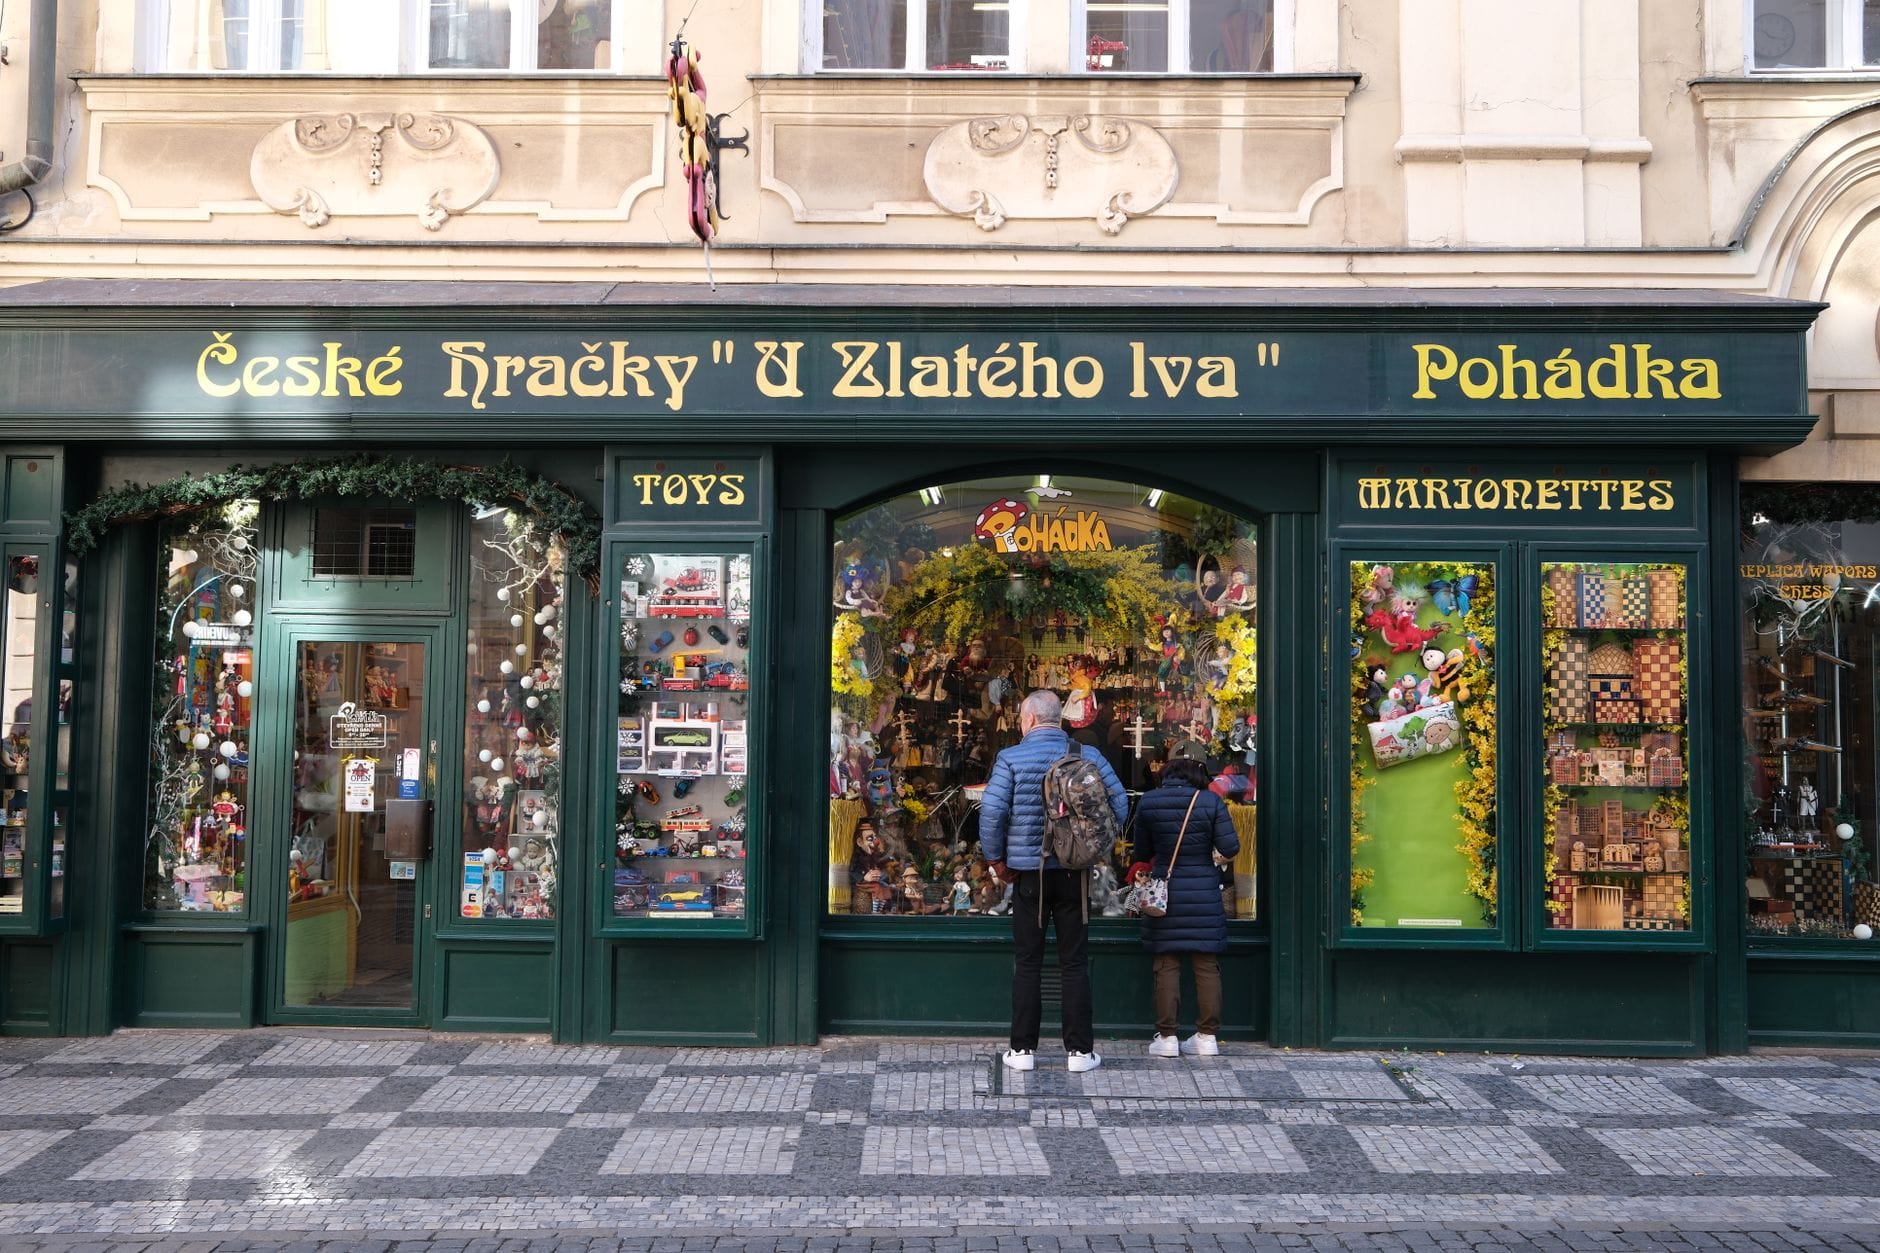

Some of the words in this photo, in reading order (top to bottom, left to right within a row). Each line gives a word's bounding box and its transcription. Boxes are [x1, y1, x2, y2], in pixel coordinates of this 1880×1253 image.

[197, 331, 404, 398] České
[442, 341, 698, 410] Hračky
[832, 341, 1104, 398] Zlatého
[1412, 343, 1722, 400] Pohádka
[632, 474, 746, 505] TOYS
[1357, 477, 1676, 511] MARIONETTES
[350, 774, 371, 782] OPEN
